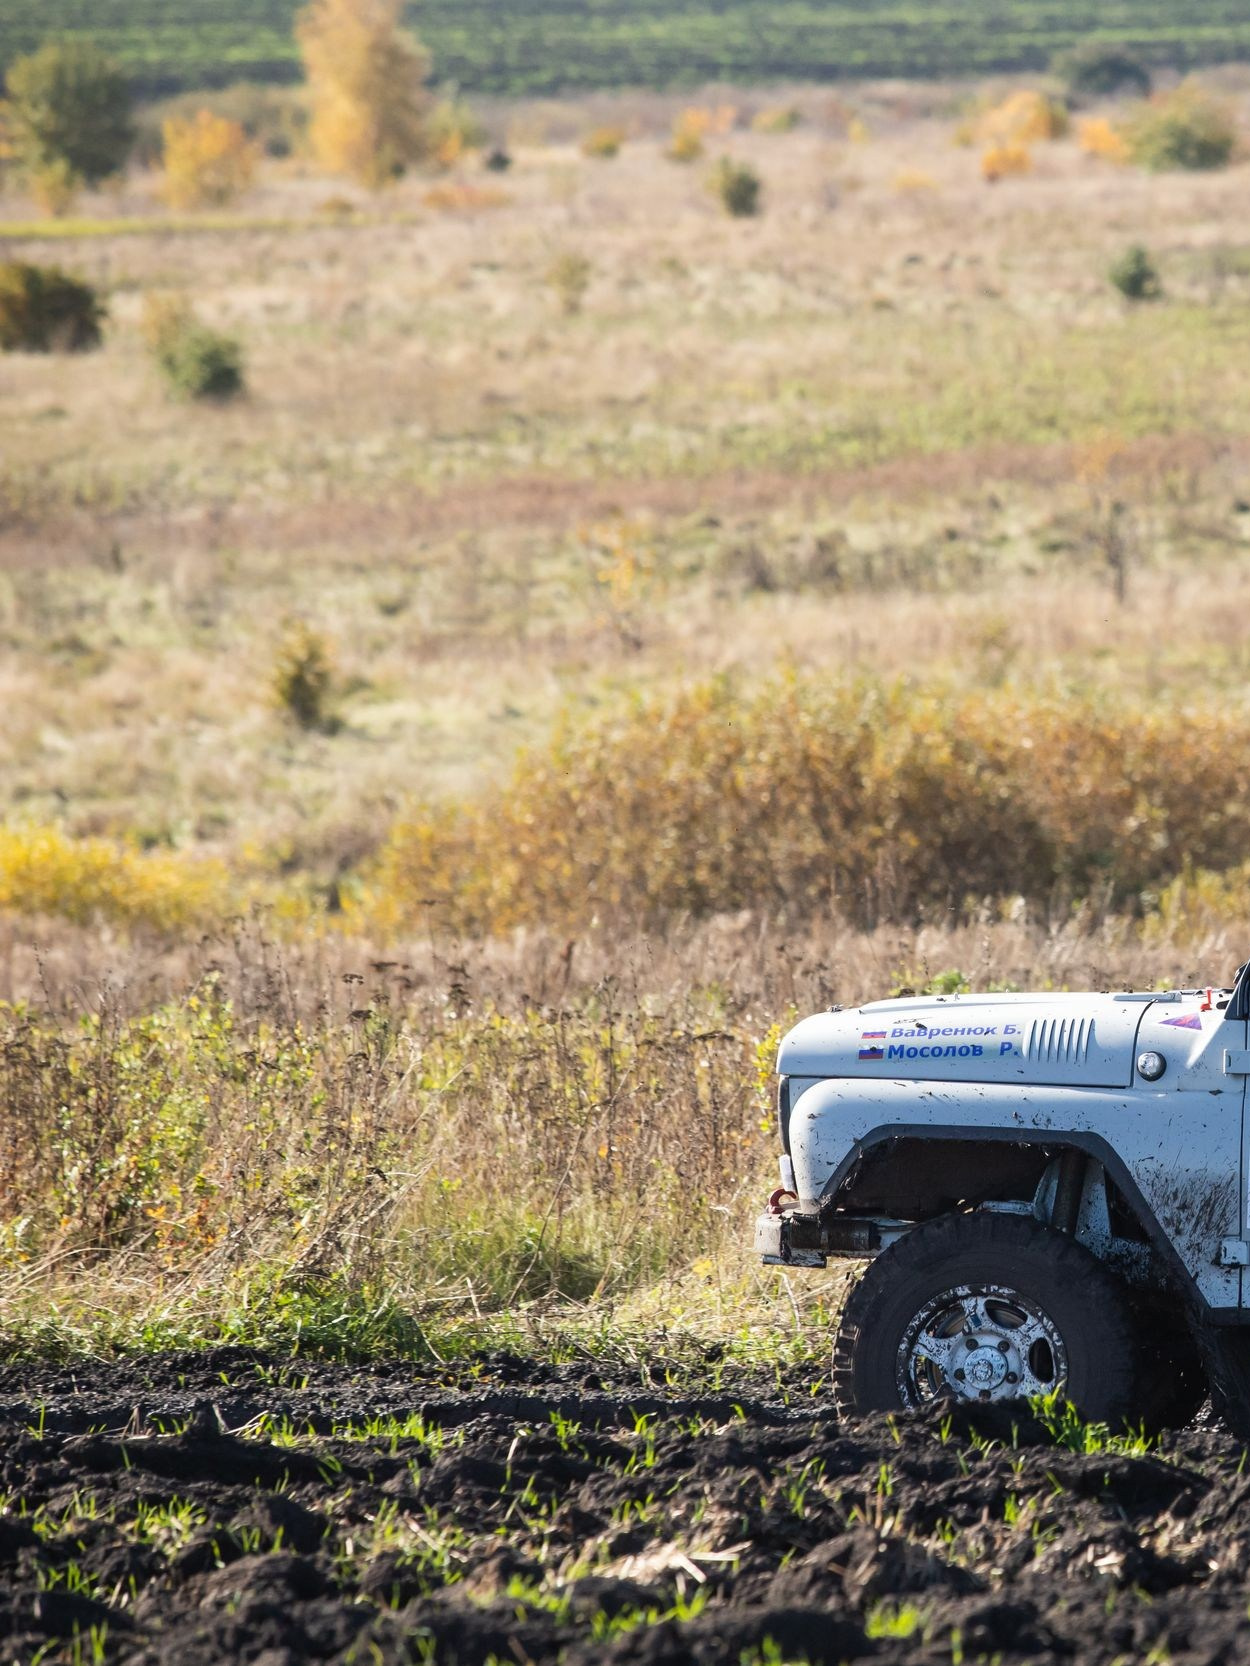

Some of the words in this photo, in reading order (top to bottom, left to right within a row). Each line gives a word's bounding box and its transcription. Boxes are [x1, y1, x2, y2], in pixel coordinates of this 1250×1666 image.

[890, 1025, 998, 1040] Вавренюк
[1003, 1024, 1022, 1036] Б.
[887, 1043, 984, 1060] Мосолов
[1000, 1041, 1019, 1056] Р.
